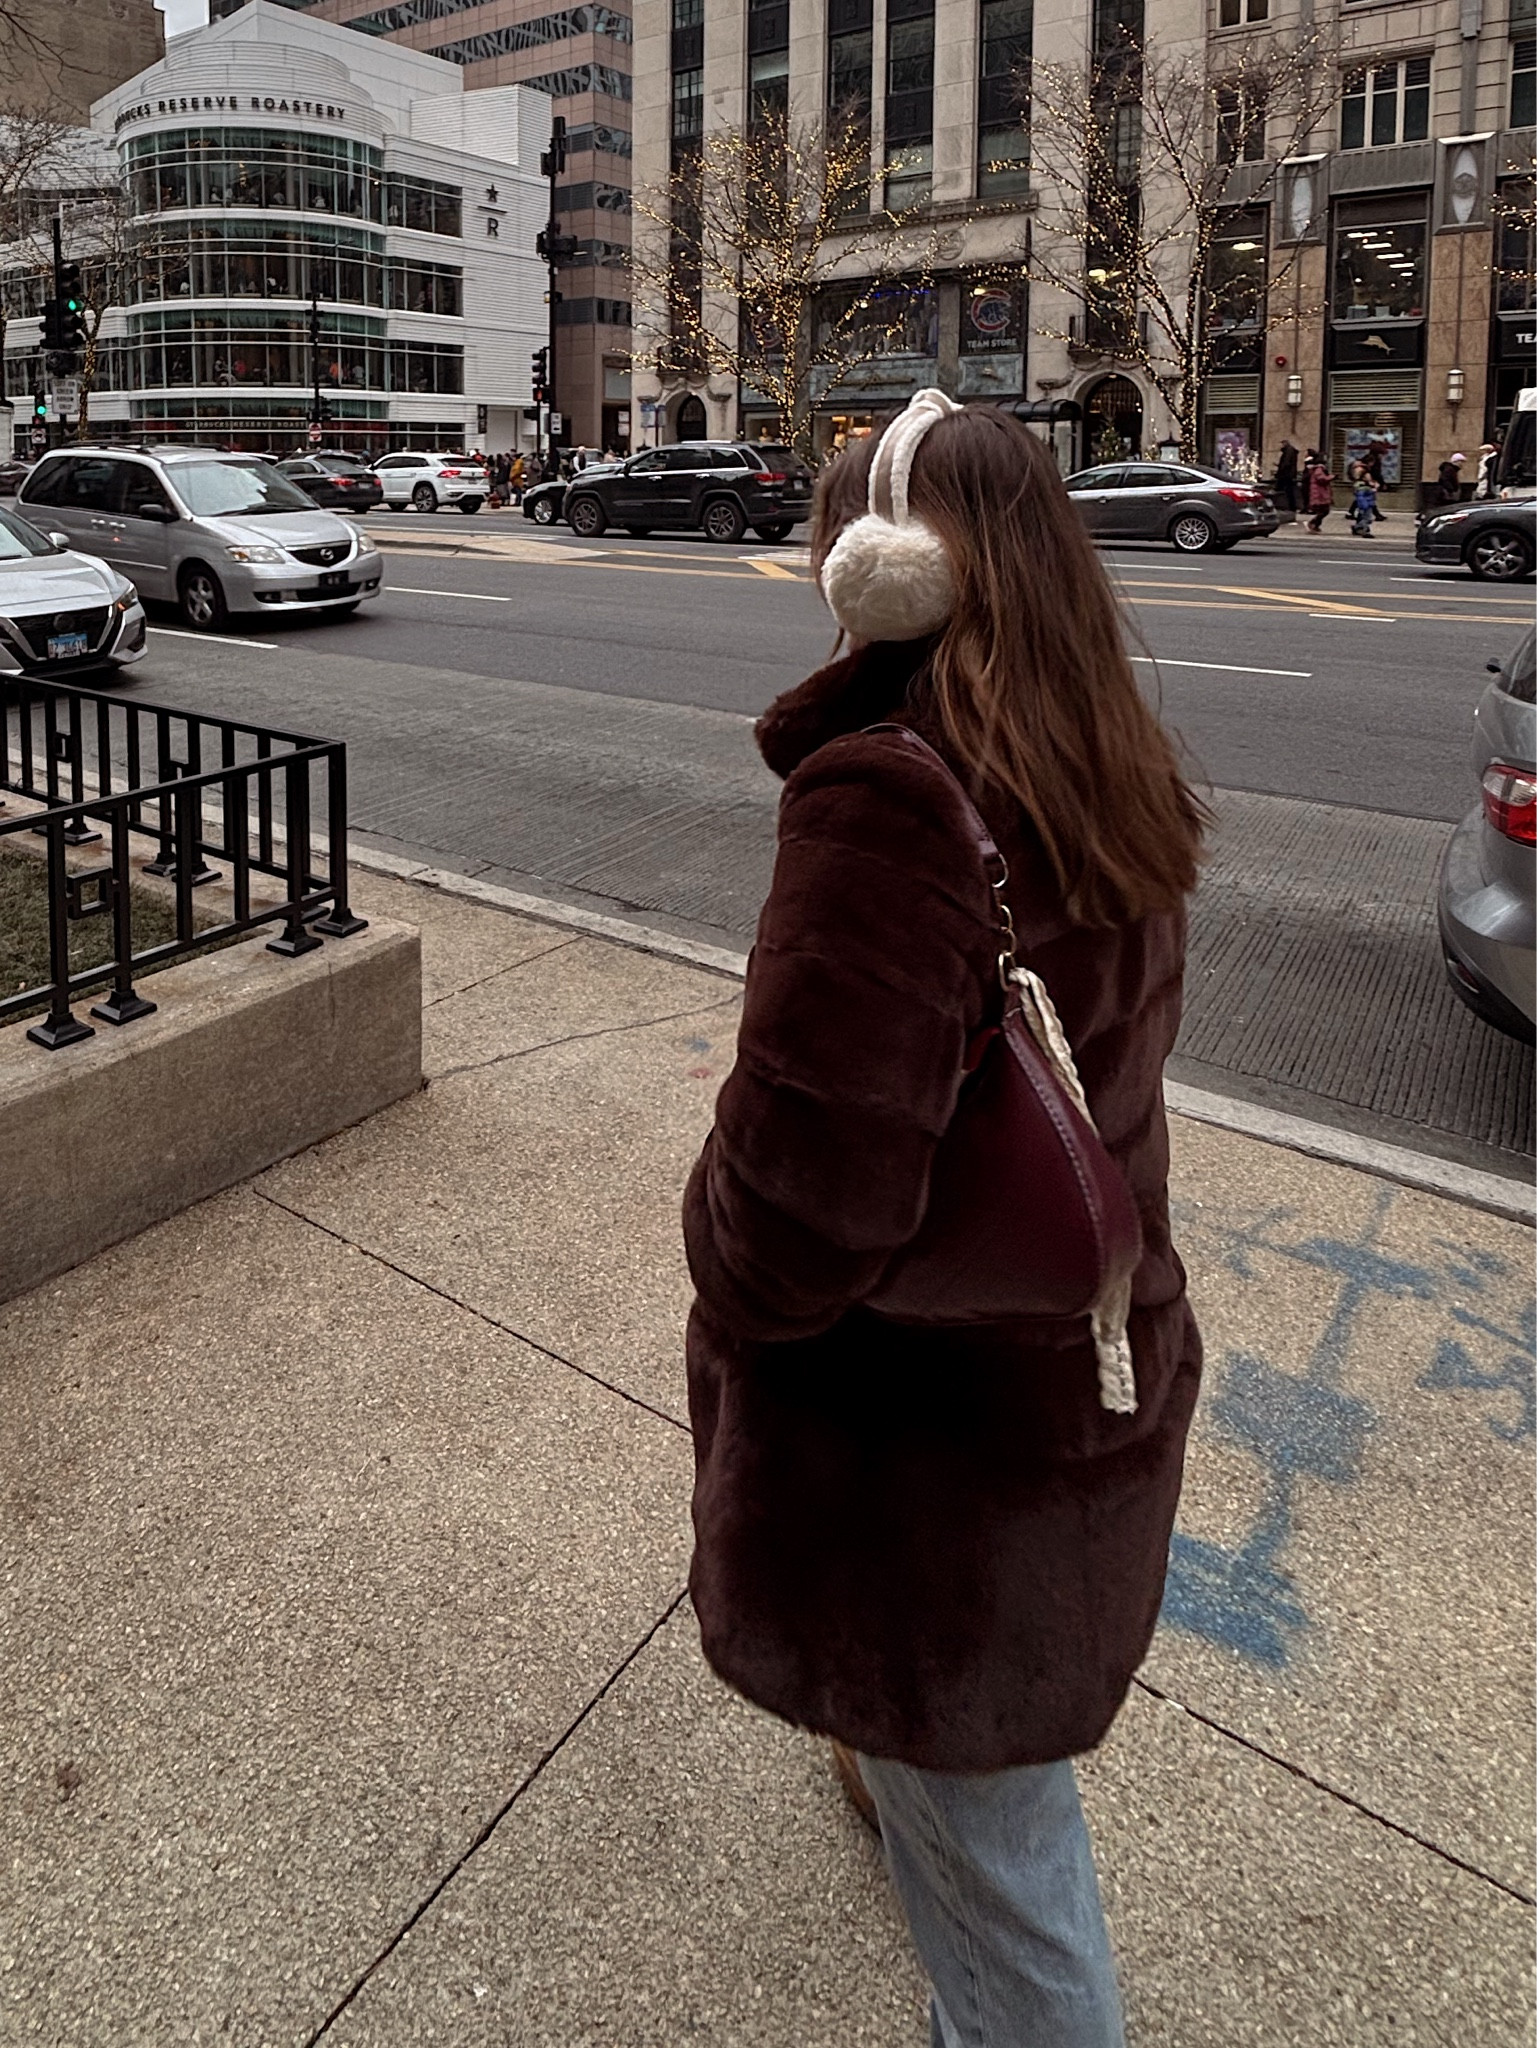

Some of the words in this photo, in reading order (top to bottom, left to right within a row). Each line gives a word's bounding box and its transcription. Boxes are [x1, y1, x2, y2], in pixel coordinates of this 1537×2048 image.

[158, 96, 238, 112] RESERVE
[251, 97, 345, 118] ROASTERY
[487, 217, 499, 236] R
[991, 339, 1017, 347] STORE
